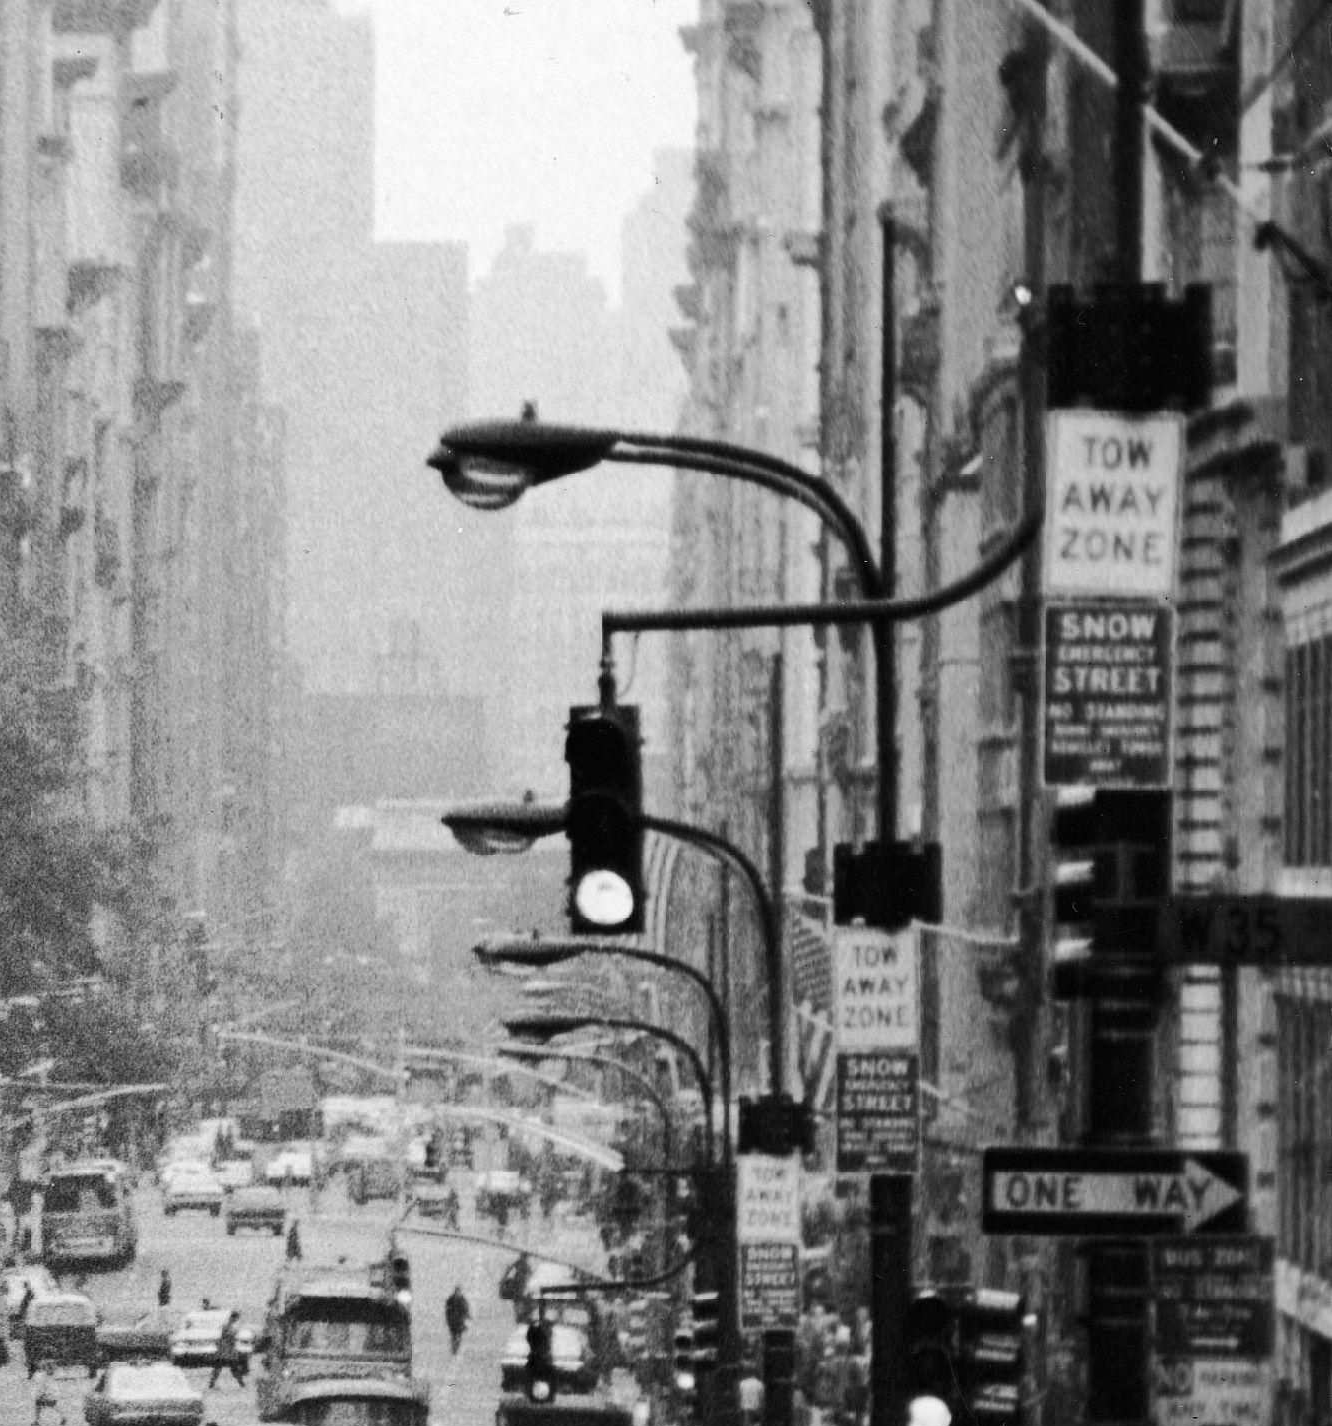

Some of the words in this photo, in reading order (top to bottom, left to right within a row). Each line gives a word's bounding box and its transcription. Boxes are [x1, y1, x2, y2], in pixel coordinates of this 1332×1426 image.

[1081, 435, 1154, 470] TOW
[1061, 483, 1167, 516] AWAY
[1060, 528, 1166, 566] ZONE
[1060, 613, 1156, 640] SNOW
[1053, 666, 1162, 693] STREET
[1048, 703, 1073, 719] NO
[1226, 906, 1283, 956] 35
[852, 945, 898, 968] TOW
[843, 978, 909, 997] AWAY
[843, 1004, 910, 1029] ZONE
[846, 1059, 910, 1077] SNOW
[842, 1094, 914, 1111] STREET
[1005, 1175, 1084, 1209] ONE
[1133, 1175, 1215, 1211] WAY
